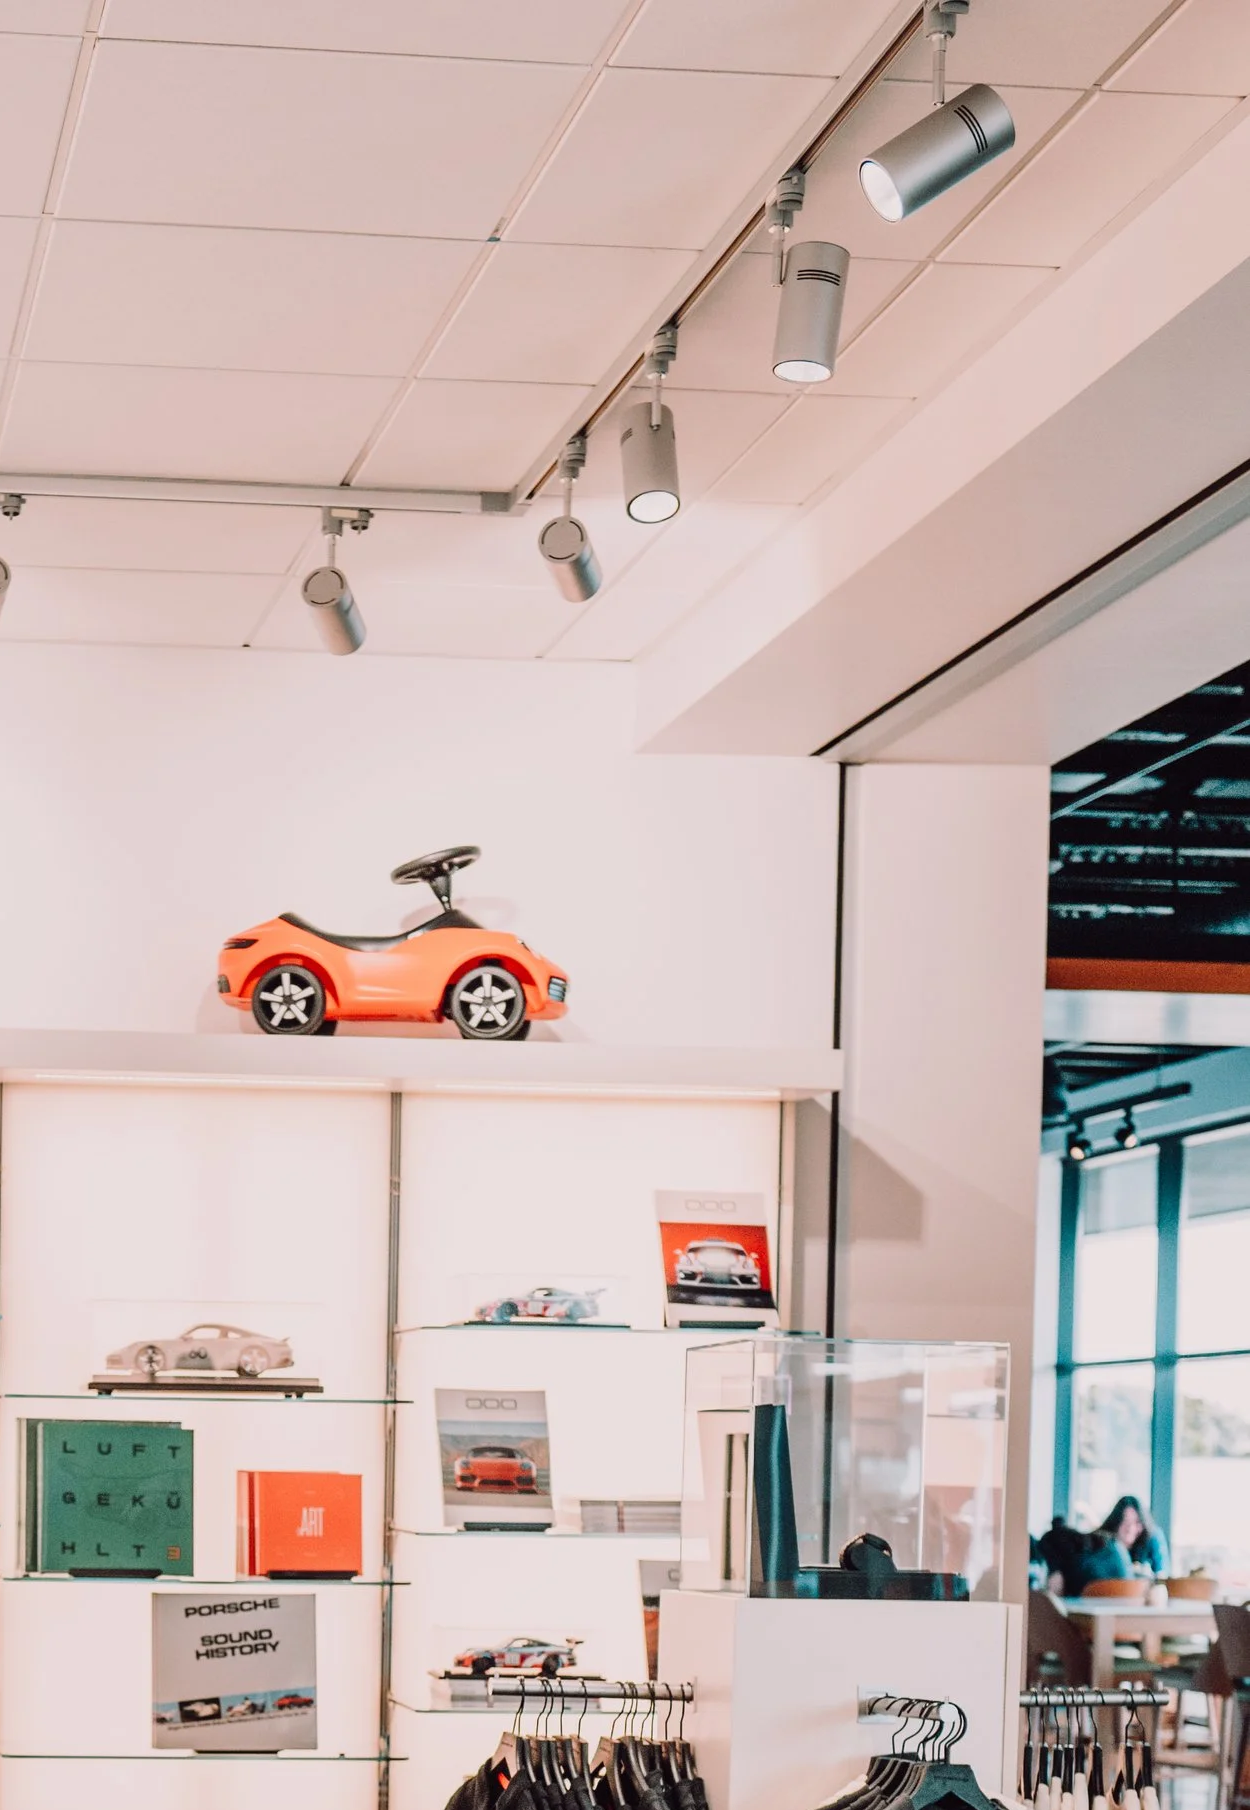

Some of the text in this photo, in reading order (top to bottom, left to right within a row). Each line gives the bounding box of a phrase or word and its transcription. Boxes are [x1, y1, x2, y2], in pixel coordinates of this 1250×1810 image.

[184, 1597, 280, 1618] PORSCHE
[200, 1628, 273, 1647] SOUND
[195, 1640, 280, 1661] HISTORY
